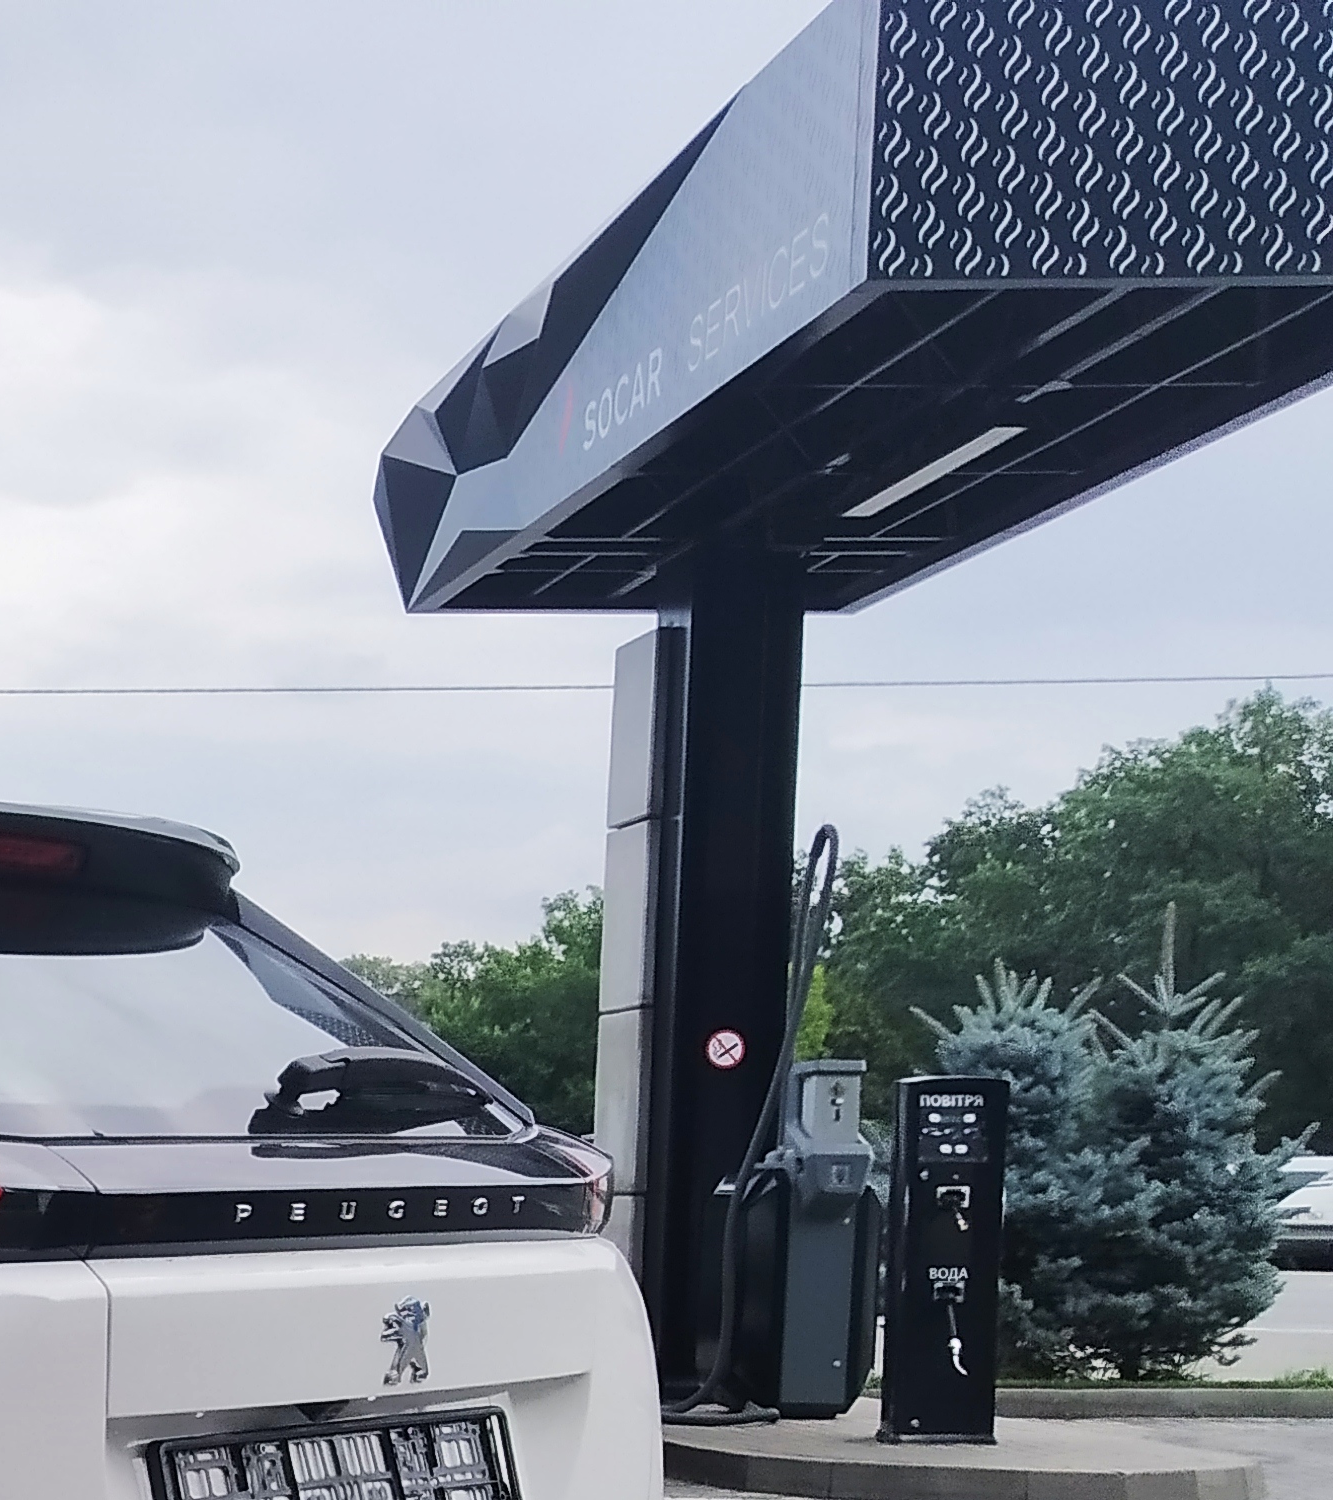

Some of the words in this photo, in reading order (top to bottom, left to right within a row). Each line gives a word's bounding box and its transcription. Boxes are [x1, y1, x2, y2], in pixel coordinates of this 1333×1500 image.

[583, 346, 663, 451] SOCAR
[687, 211, 830, 373] SERVICES
[919, 1093, 984, 1108] ПОВІТРЯ
[234, 1195, 525, 1223] PEUGEOT
[929, 1267, 969, 1282] ВОДА
